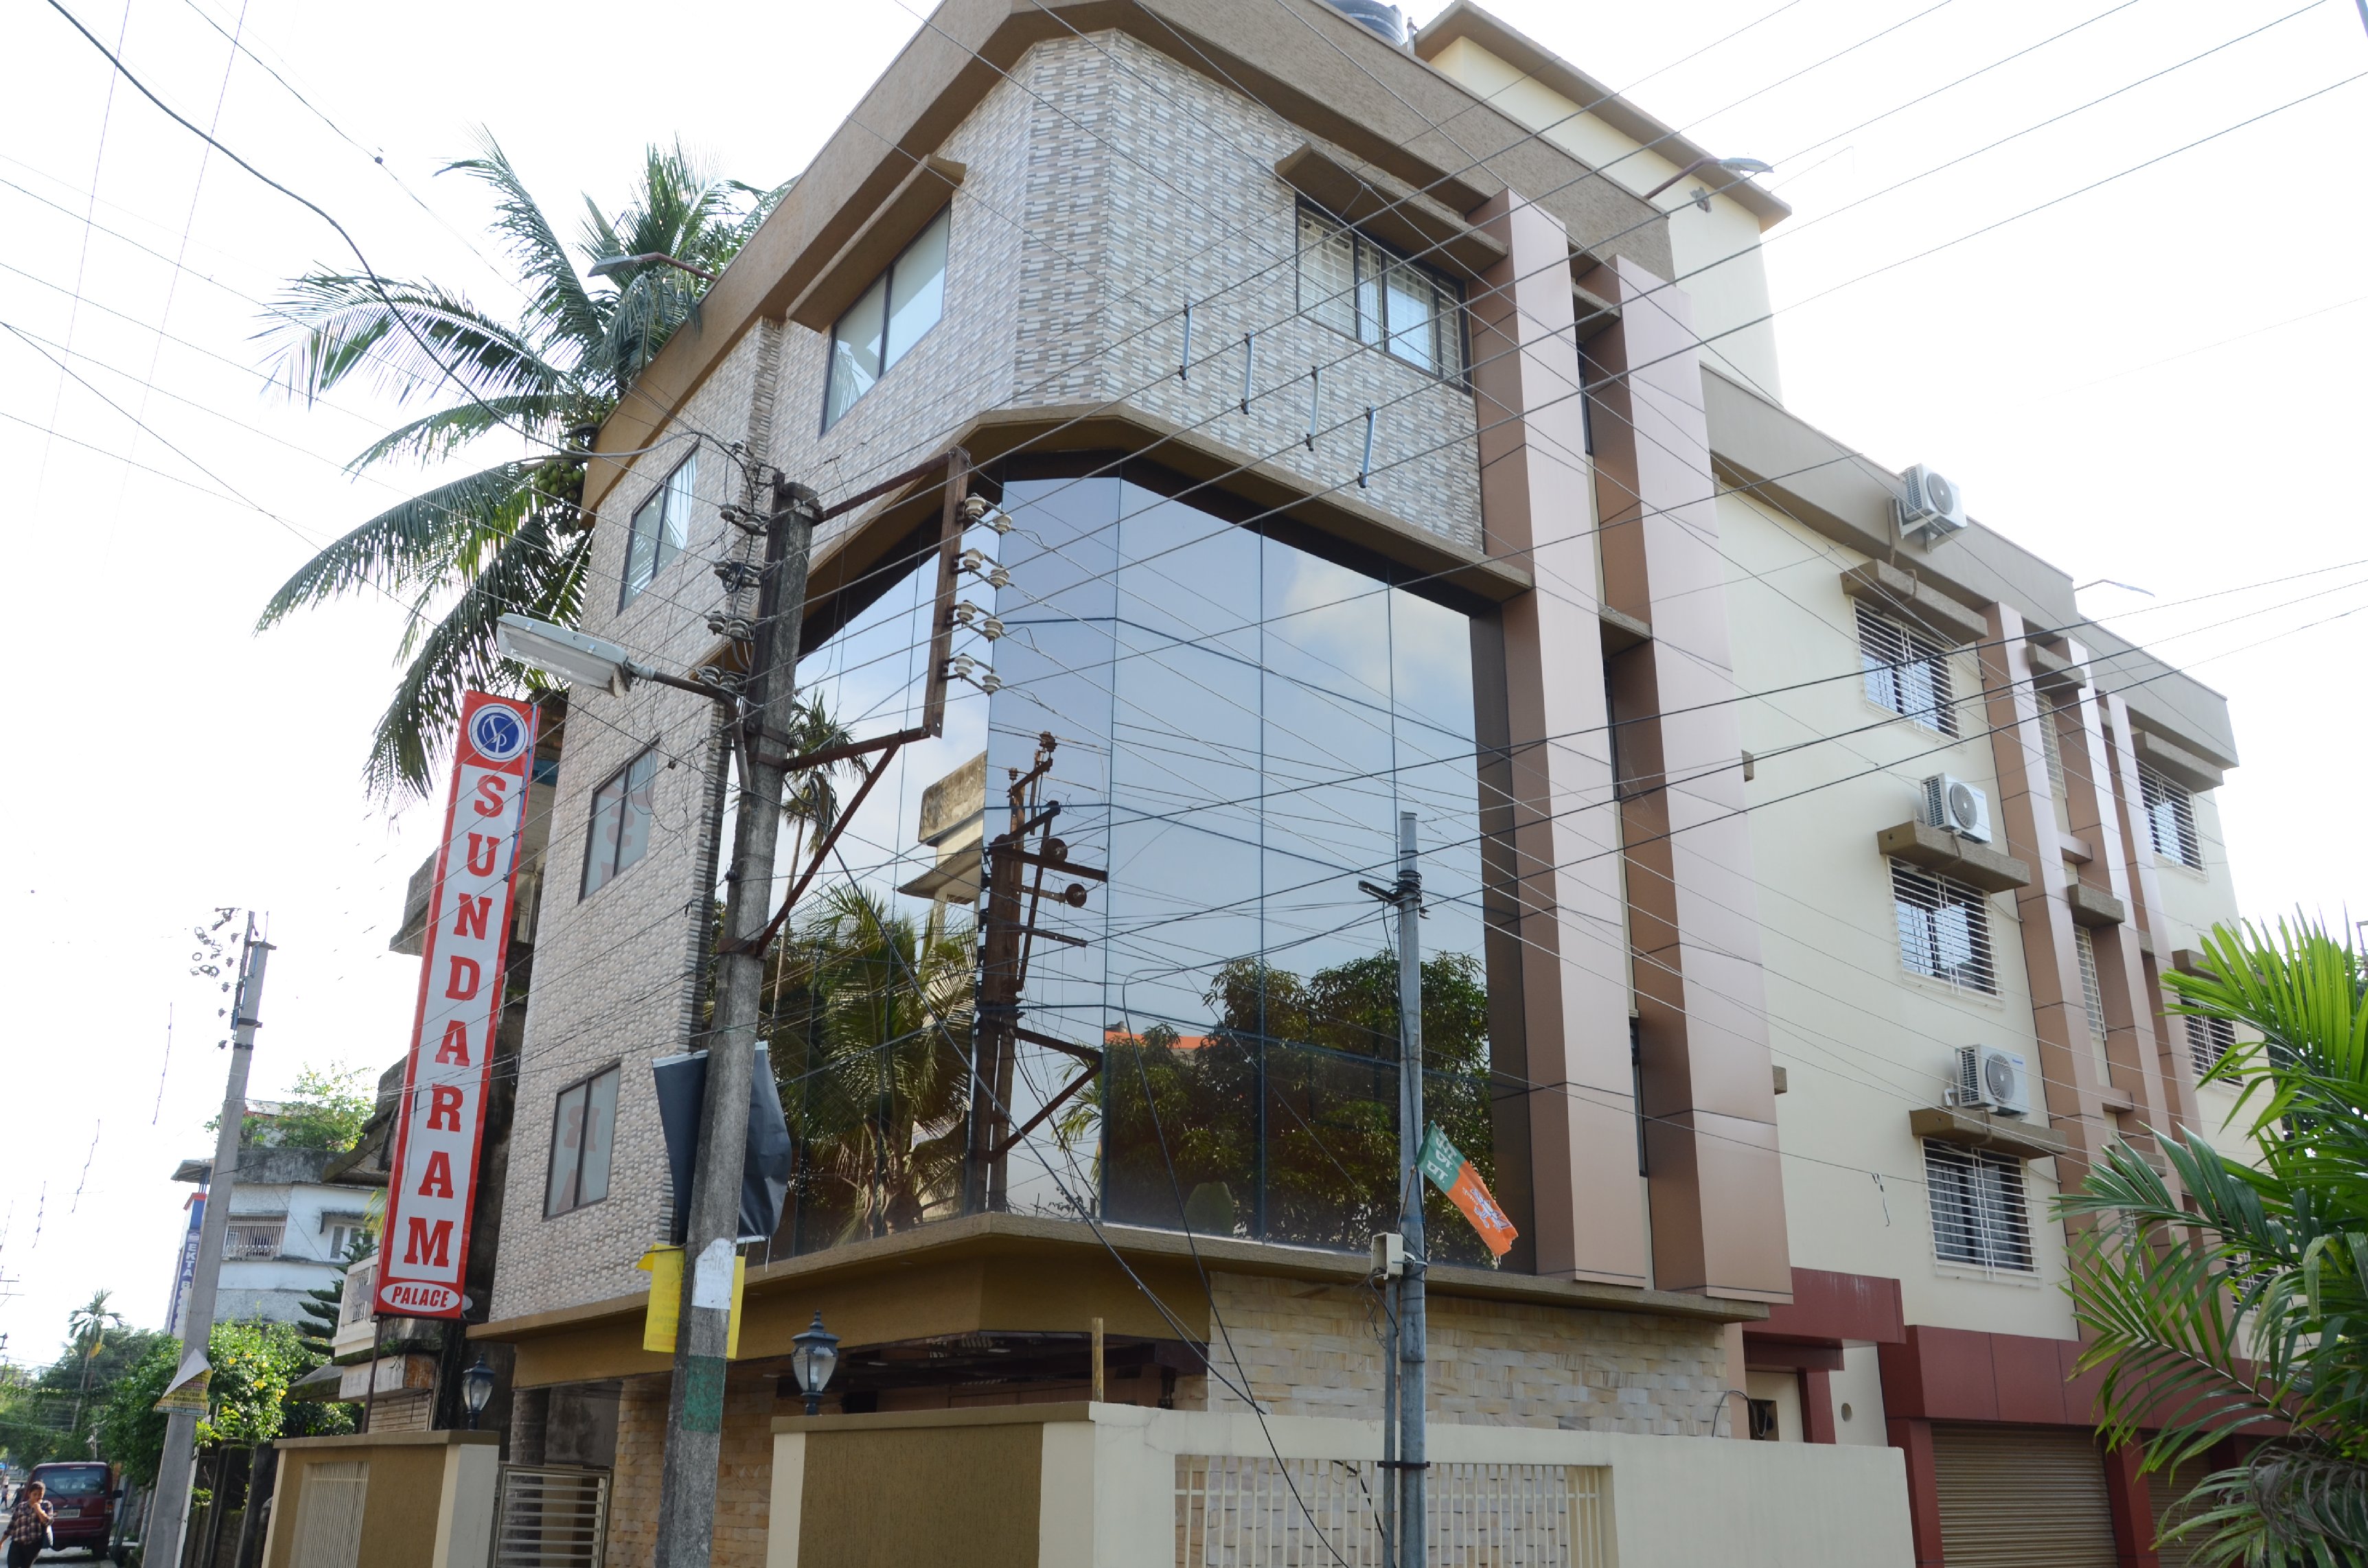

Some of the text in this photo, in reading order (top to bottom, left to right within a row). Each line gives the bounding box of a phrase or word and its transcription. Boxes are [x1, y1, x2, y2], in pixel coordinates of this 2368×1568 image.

[404, 774, 507, 1268] SUNDARAM
[183, 1244, 197, 1277] EKTA
[391, 1286, 449, 1308] PALACE
